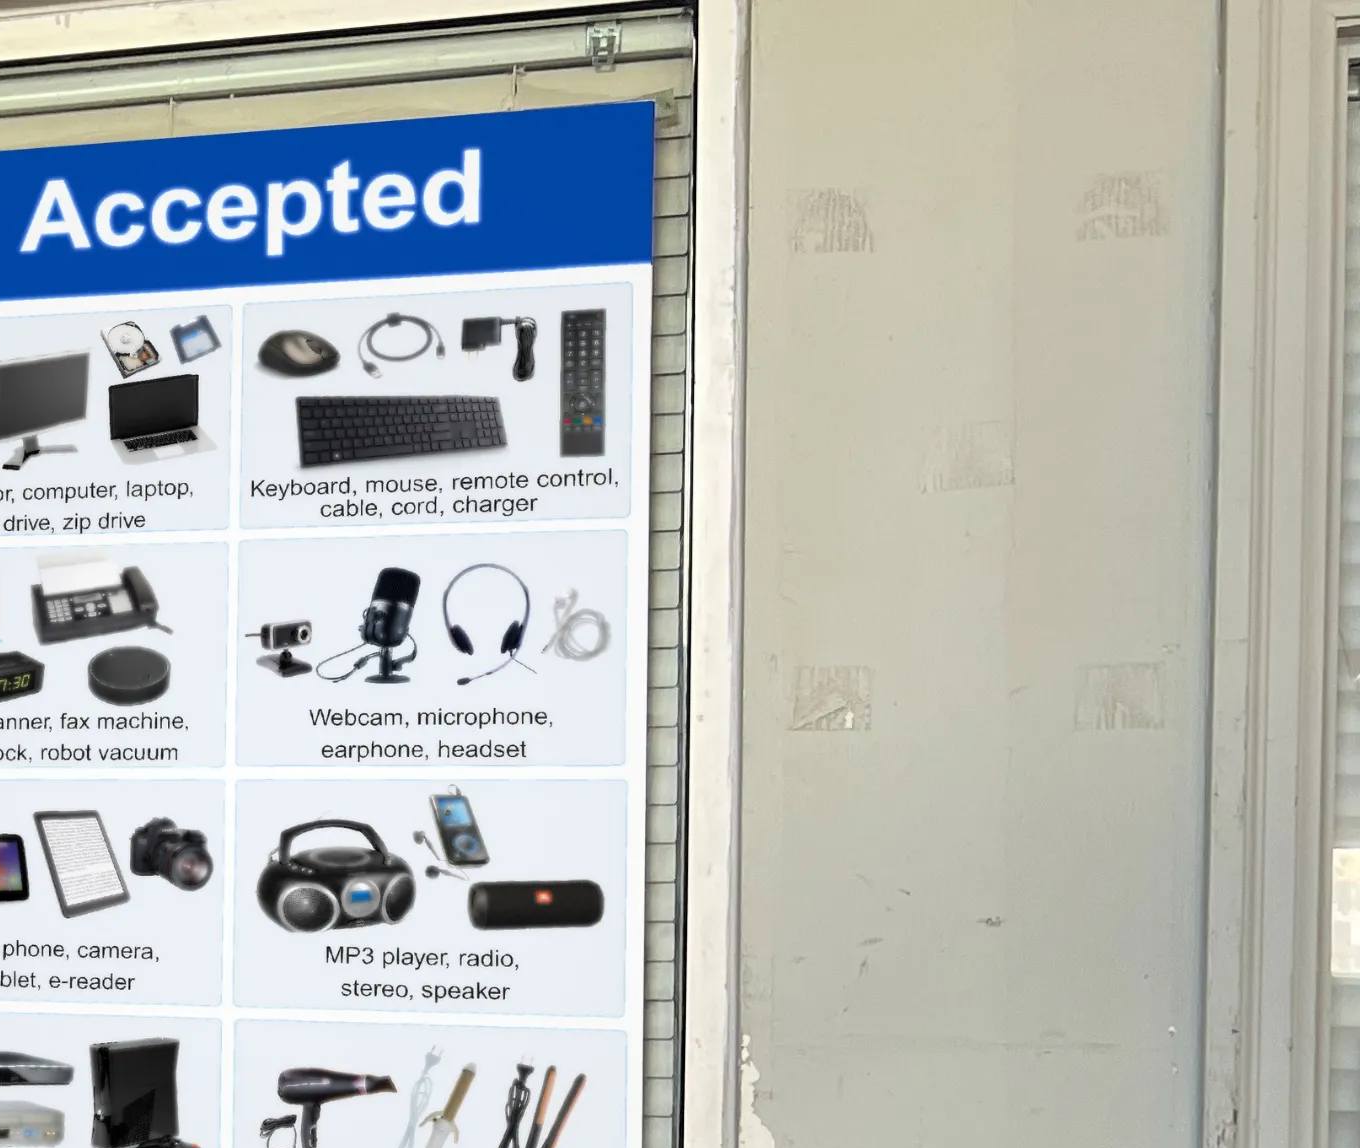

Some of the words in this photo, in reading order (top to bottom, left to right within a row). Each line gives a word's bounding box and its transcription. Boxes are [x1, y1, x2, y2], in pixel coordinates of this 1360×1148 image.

[20, 149, 480, 256] Accepted
[22, 482, 117, 503] computer,
[126, 480, 193, 501] laptop,
[251, 476, 356, 501] Keyboard,
[366, 478, 442, 493] mouse,
[452, 472, 529, 490] remote
[537, 467, 618, 488] control,
[320, 499, 382, 518] cable,
[391, 496, 444, 517] cord,
[452, 495, 538, 516] charger
[3, 514, 54, 533] drive,
[62, 512, 91, 534] zip
[98, 511, 145, 529] drive
[97, 711, 188, 730] machine,
[309, 708, 409, 728] Webcam,
[417, 707, 552, 729] microphone,
[41, 743, 91, 761] robot
[98, 747, 178, 761] vacuum
[321, 740, 428, 762] earphone,
[438, 739, 526, 758] headset
[3, 939, 69, 960] phone,
[77, 945, 159, 962] camera,
[326, 945, 374, 964] MP3
[383, 947, 449, 970] player,
[459, 949, 518, 970] radio,
[49, 973, 135, 990] e-reader
[341, 980, 413, 1000] stereo,
[421, 981, 510, 1003] speaker
